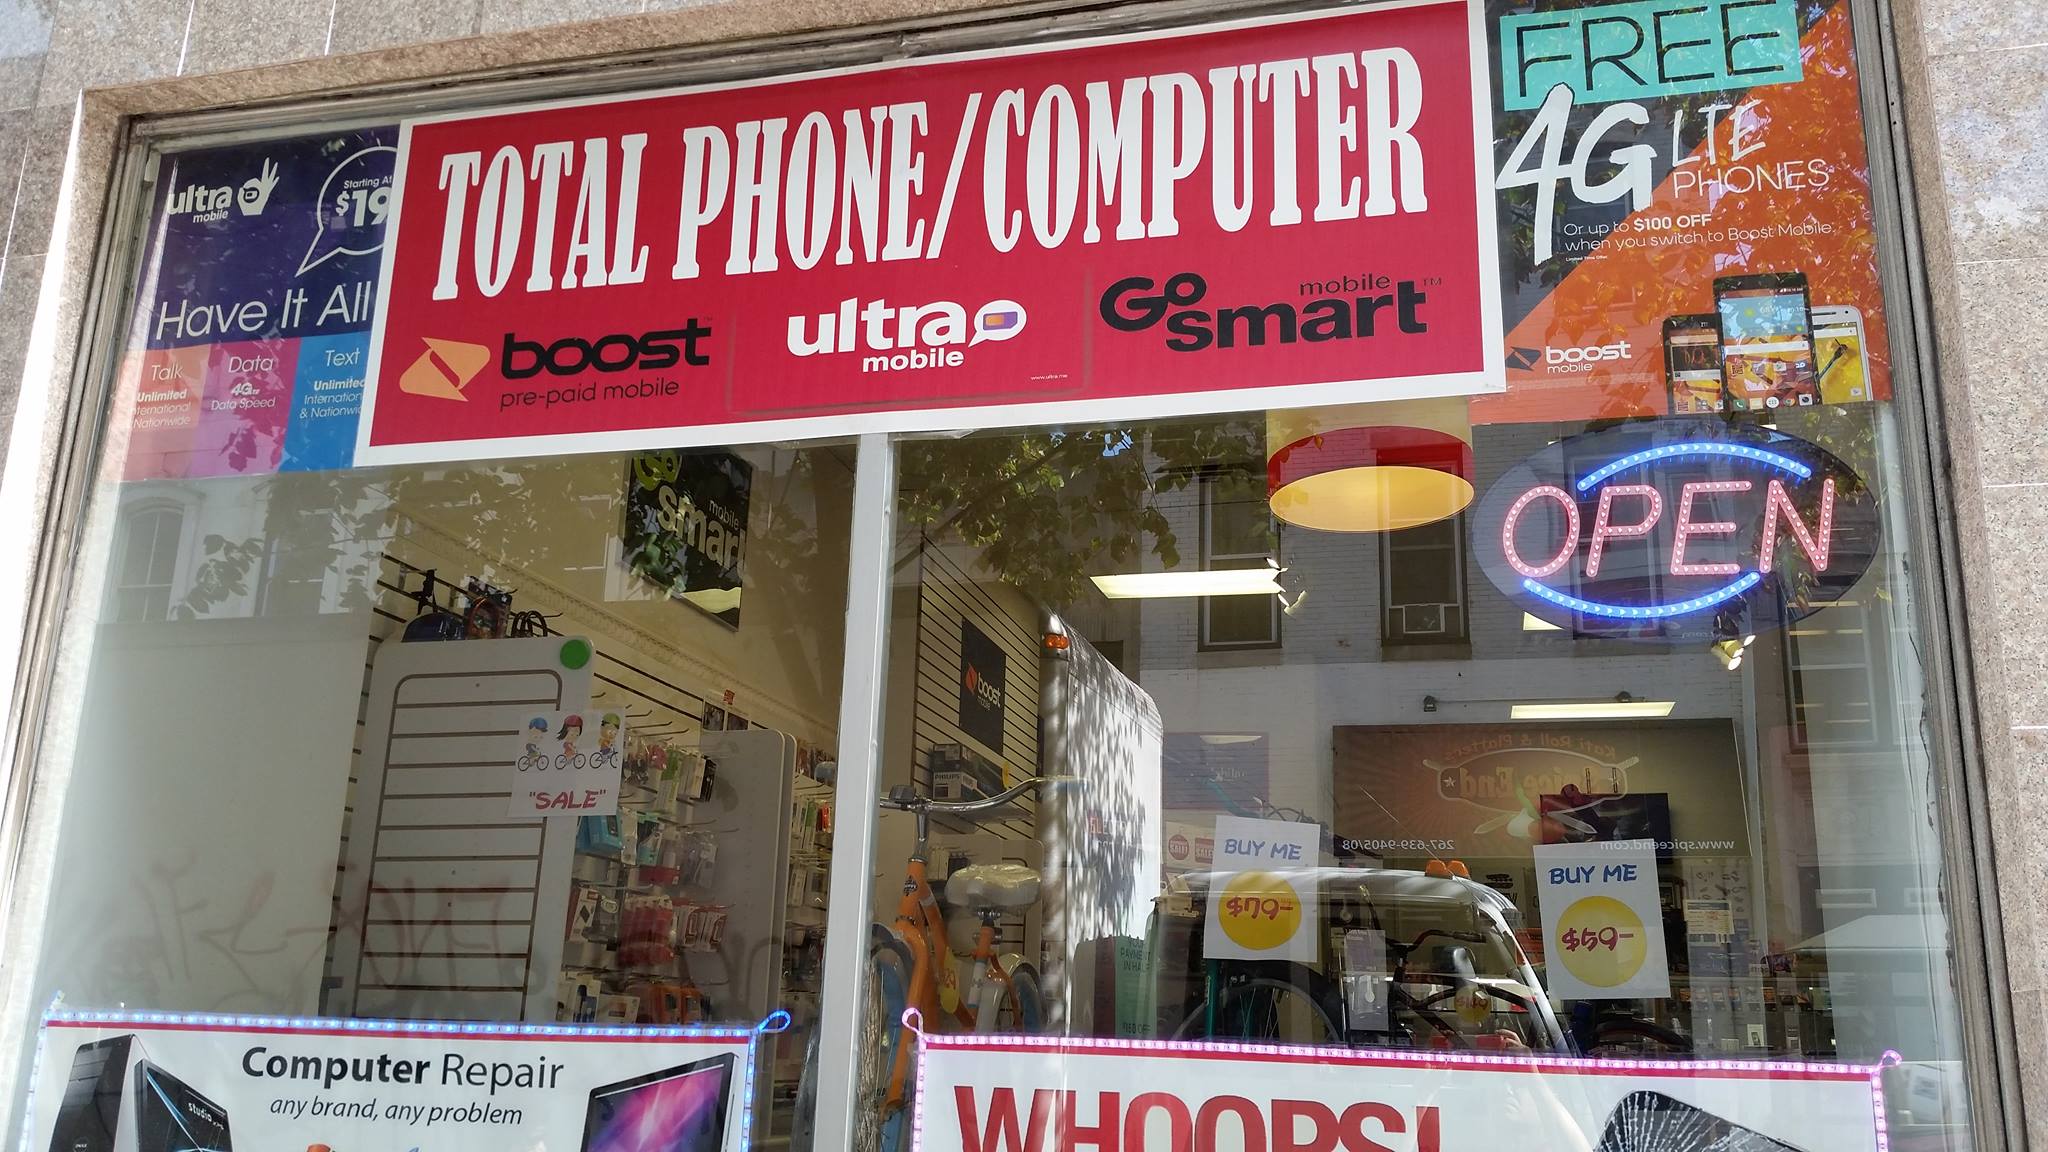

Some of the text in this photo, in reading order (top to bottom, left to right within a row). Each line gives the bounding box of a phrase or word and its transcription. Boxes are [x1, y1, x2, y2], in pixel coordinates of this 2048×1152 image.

[1515, 1, 1785, 98] FREE
[344, 178, 380, 189] Starting
[432, 46, 1428, 301] TOTAL PHONE/COMPUTER
[1495, 82, 1768, 266] 4G LTE
[1672, 158, 1831, 199] PHONES
[167, 184, 233, 215] ultra
[335, 186, 392, 228] $19
[193, 209, 229, 223] mobile
[1563, 213, 1713, 237] Or up to $100 OFF
[1564, 236, 1612, 252] when
[1615, 237, 1647, 251] you
[1650, 231, 1704, 247] switch
[1707, 229, 1725, 243] to
[1728, 226, 1775, 242] Boost
[1300, 273, 1391, 297] mobile
[155, 280, 372, 341] Have It All
[787, 297, 968, 357] ultra
[325, 347, 361, 367] Text
[500, 318, 712, 380] boost
[862, 347, 965, 373] mobile
[1545, 341, 1632, 364] boost
[151, 363, 184, 381] Talk
[228, 354, 275, 374] Data
[1547, 362, 1593, 374] mobile
[137, 388, 187, 402] Unlimited
[211, 397, 276, 411] Data Speed
[500, 377, 680, 412] pre-paid mobile
[299, 408, 309, 419] &
[708, 500, 740, 532] mobile
[1502, 479, 1835, 578] OPEN
[977, 671, 1001, 708] boost
[1224, 838, 1303, 861] BUY ME
[1548, 863, 1638, 886] BUY ME
[242, 1046, 565, 1095] Computer Repair
[187, 1101, 213, 1123] studio
[270, 1095, 523, 1126] any brand, any problem
